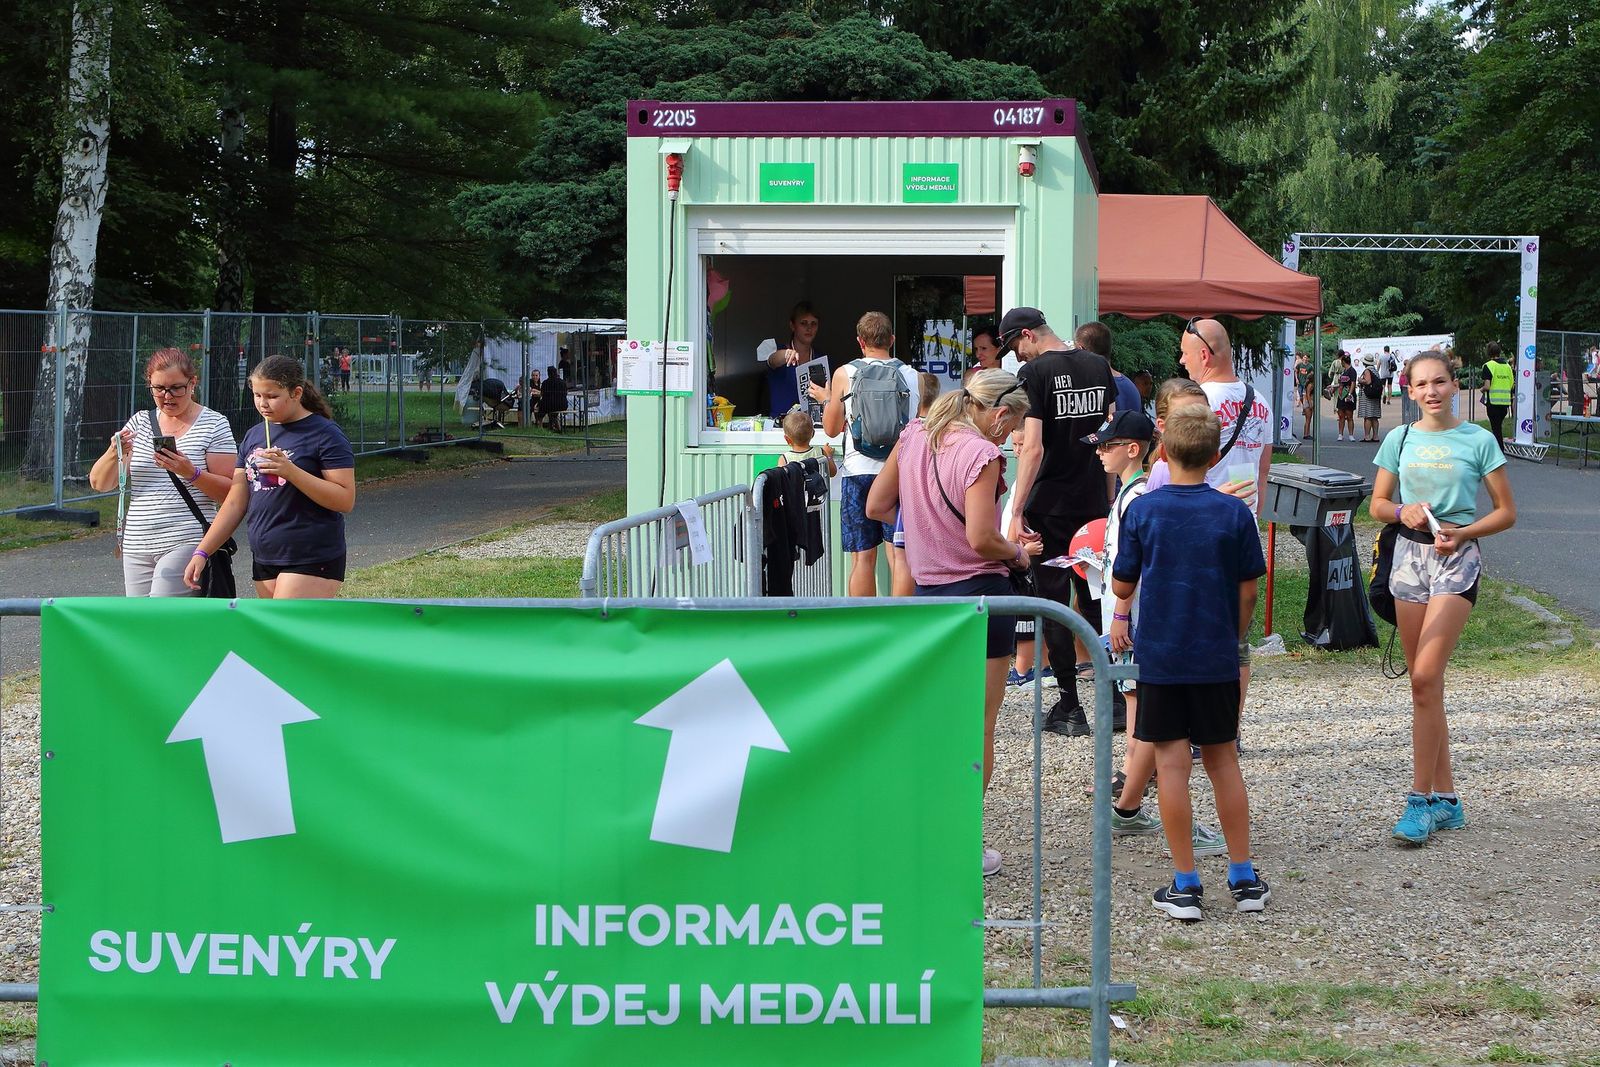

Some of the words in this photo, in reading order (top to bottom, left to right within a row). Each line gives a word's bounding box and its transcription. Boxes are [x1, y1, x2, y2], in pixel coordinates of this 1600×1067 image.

[653, 109, 696, 127] 2205
[993, 107, 1044, 126] 04187
[769, 178, 805, 187] SUVENÝRY
[1054, 375, 1072, 389] HER
[1056, 390, 1104, 416] DEMON
[535, 903, 883, 946] INFORMACE
[88, 922, 397, 980] SUVENÝRY
[485, 970, 681, 1026] VÝDEJ
[700, 969, 936, 1025] MEDAILÍ
